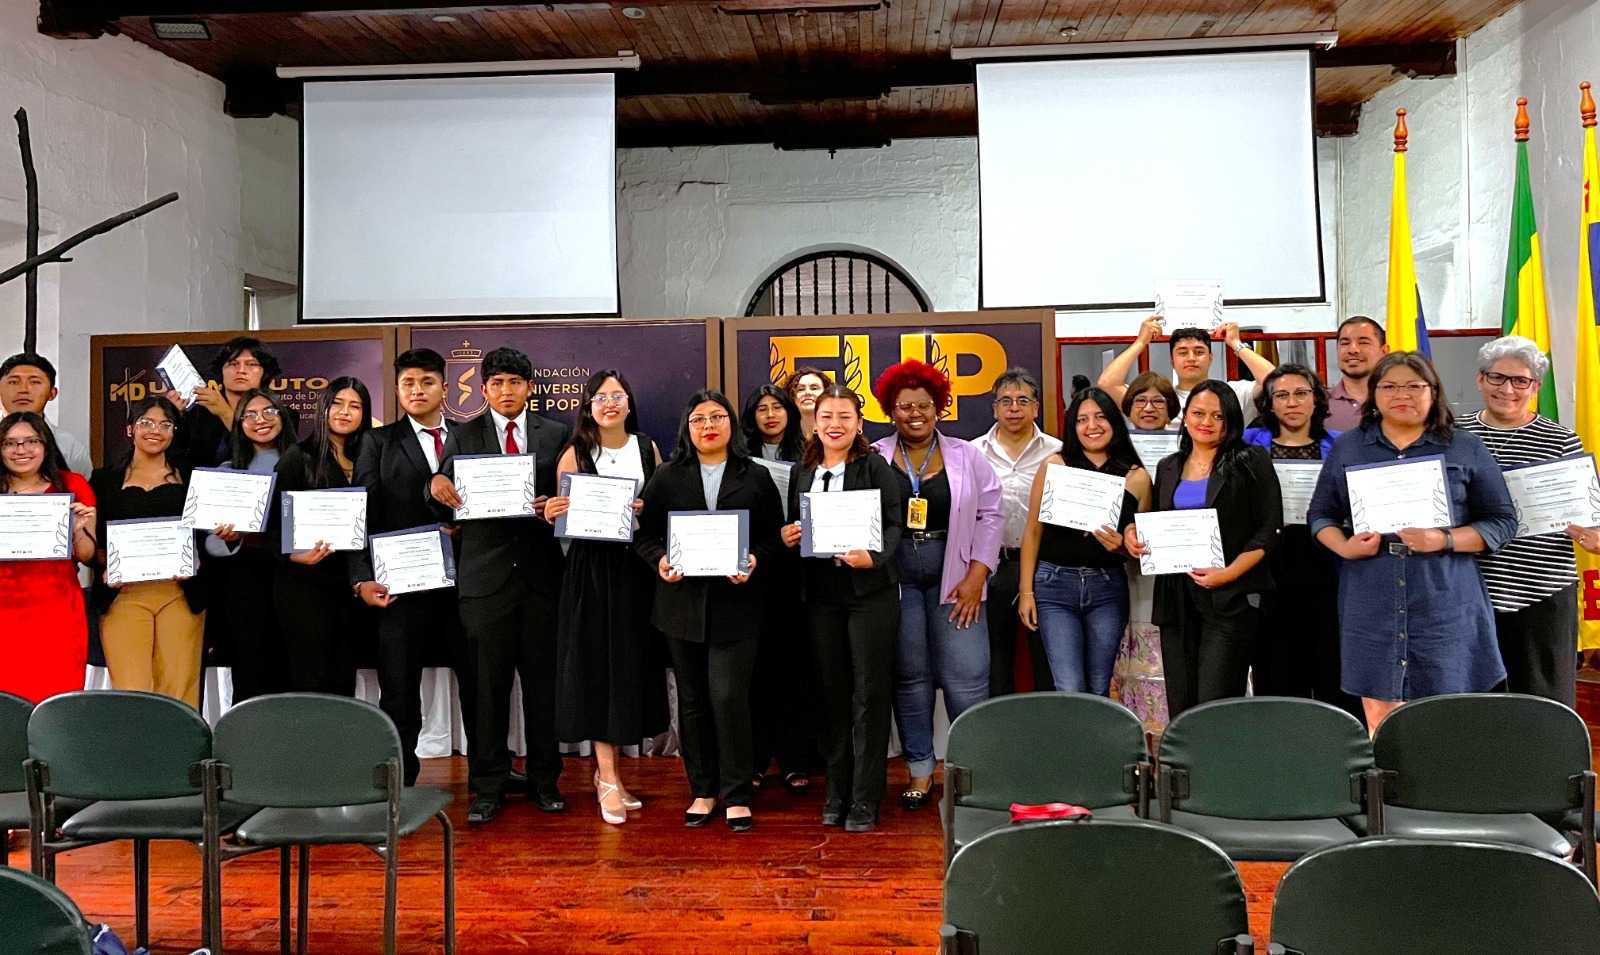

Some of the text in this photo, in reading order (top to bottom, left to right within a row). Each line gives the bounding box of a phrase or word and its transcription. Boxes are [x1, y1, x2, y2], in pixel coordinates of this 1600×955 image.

[534, 366, 590, 378] NDACIÓN
[770, 332, 1008, 424] FUP
[531, 383, 587, 395] NIVERSI
[295, 391, 306, 400] de
[545, 398, 580, 411] POP
